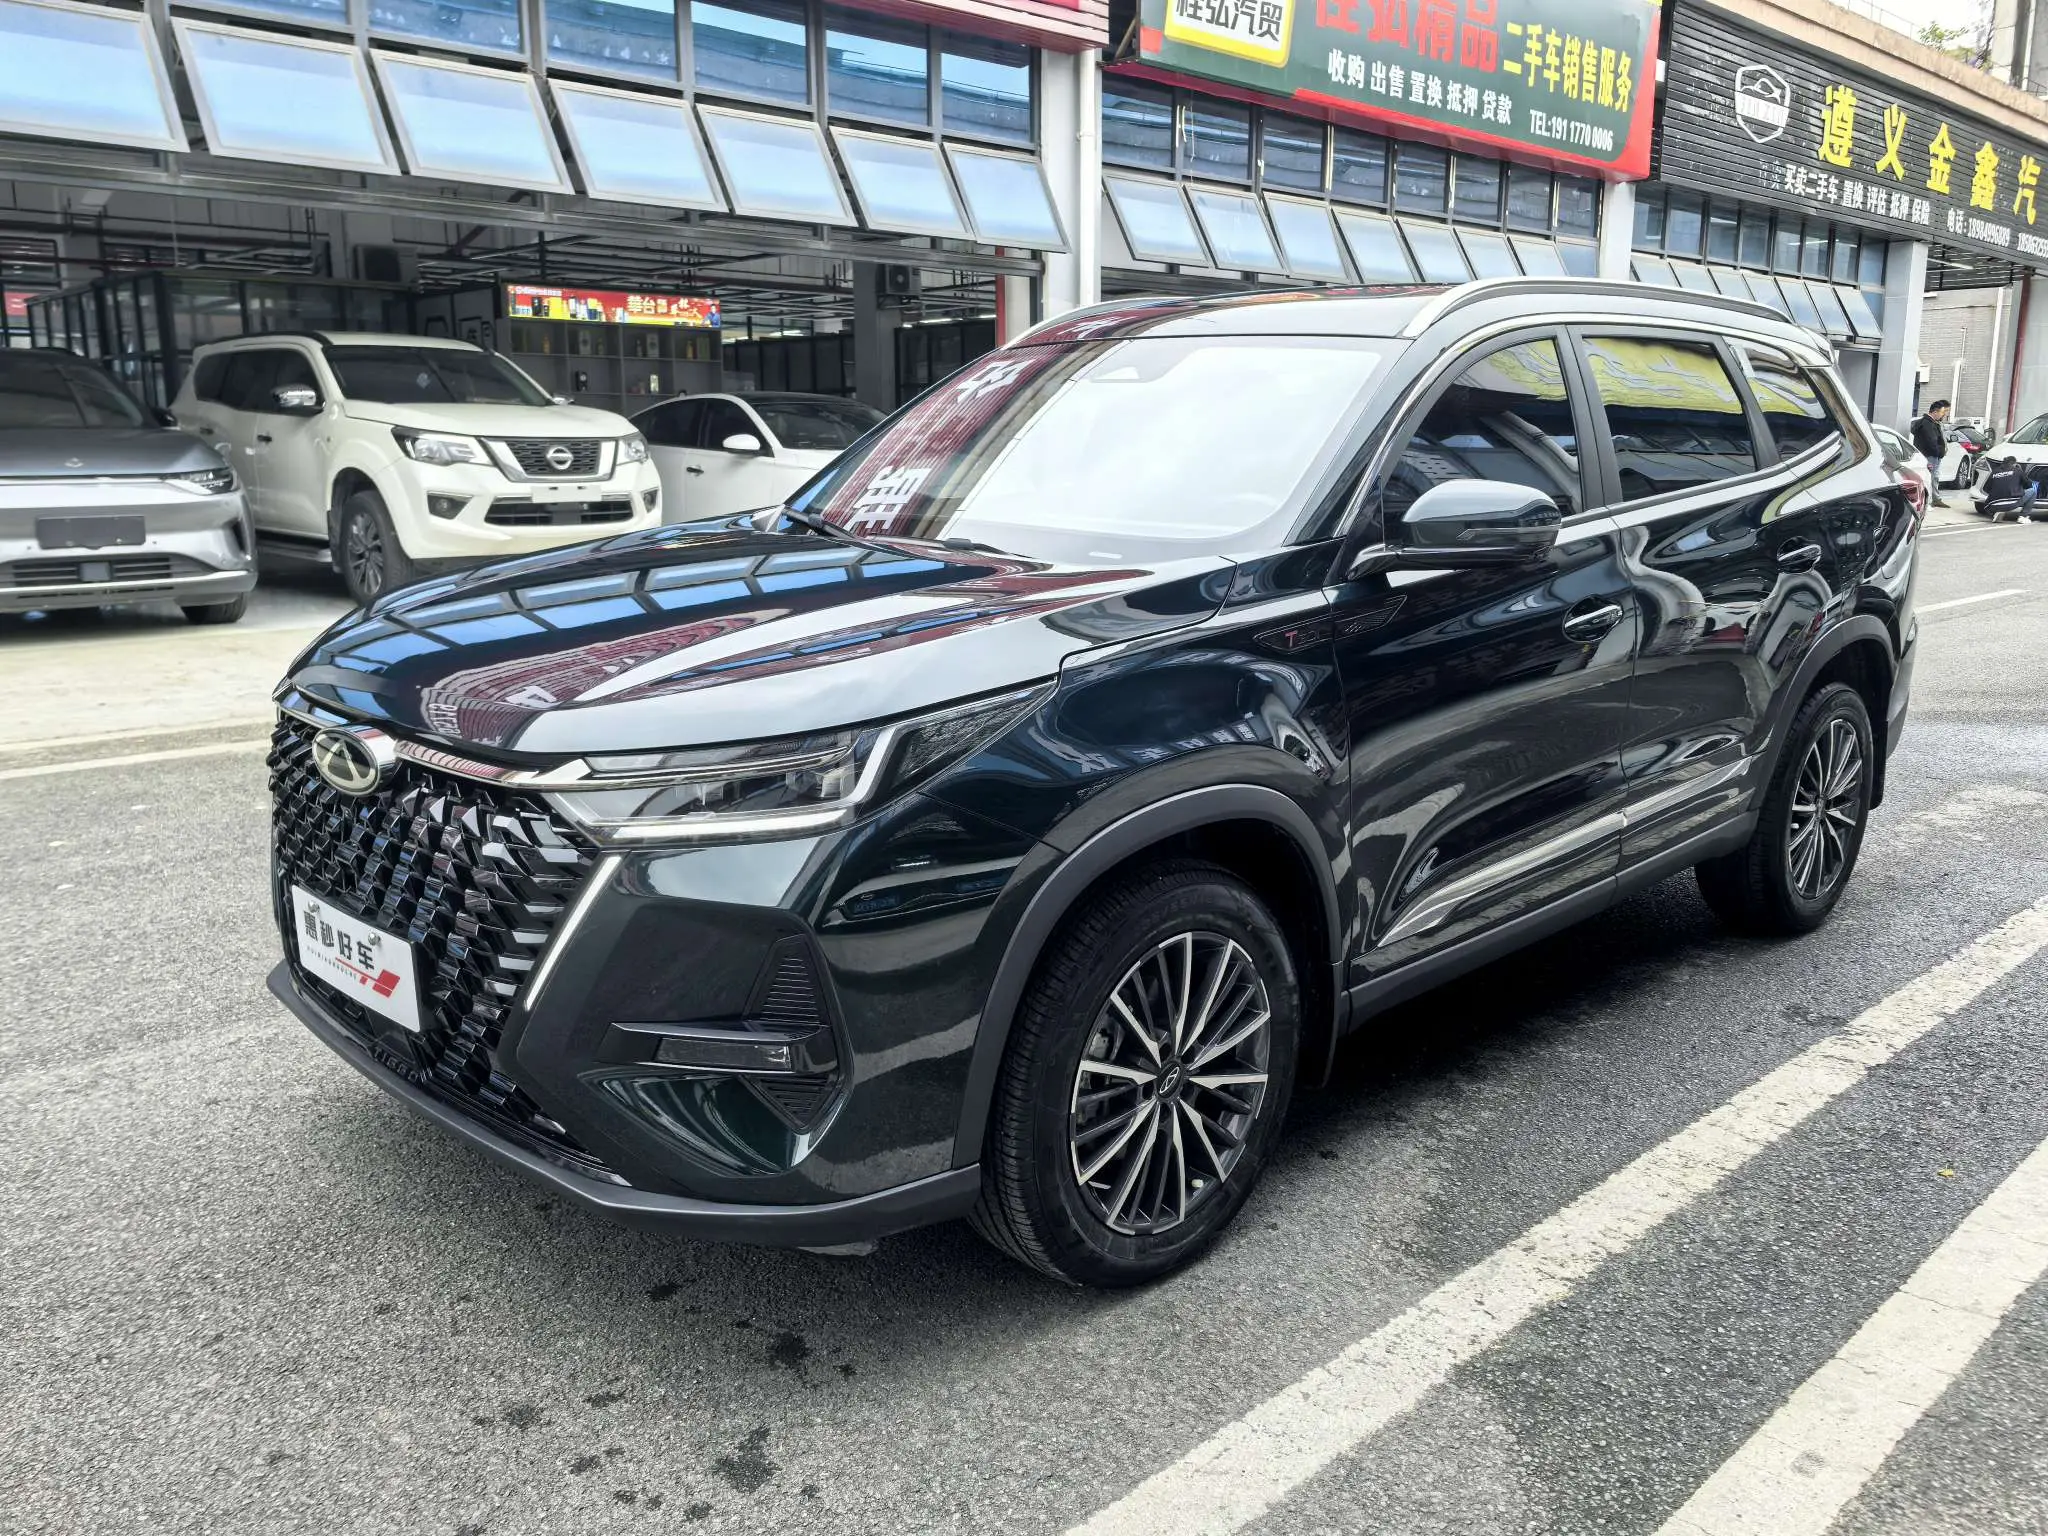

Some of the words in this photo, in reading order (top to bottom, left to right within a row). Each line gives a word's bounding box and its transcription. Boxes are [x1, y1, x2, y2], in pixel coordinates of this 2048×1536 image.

[1328, 48, 1365, 89] 收购
[1370, 60, 1405, 99] 出售
[1409, 70, 1443, 109] 置换
[1446, 80, 1479, 117] 抵押
[1482, 89, 1512, 126] 贷款
[1503, 21, 1632, 113] 二手车销售服务
[1529, 109, 1568, 141] TEL:191
[1817, 84, 2042, 226] 遵义金鑫汽
[1784, 163, 1839, 204] 买卖二手车
[1841, 180, 1864, 211] 置换
[1866, 185, 1888, 216] 评估
[1889, 192, 1911, 221] 抵押
[1911, 198, 1931, 226] 保险
